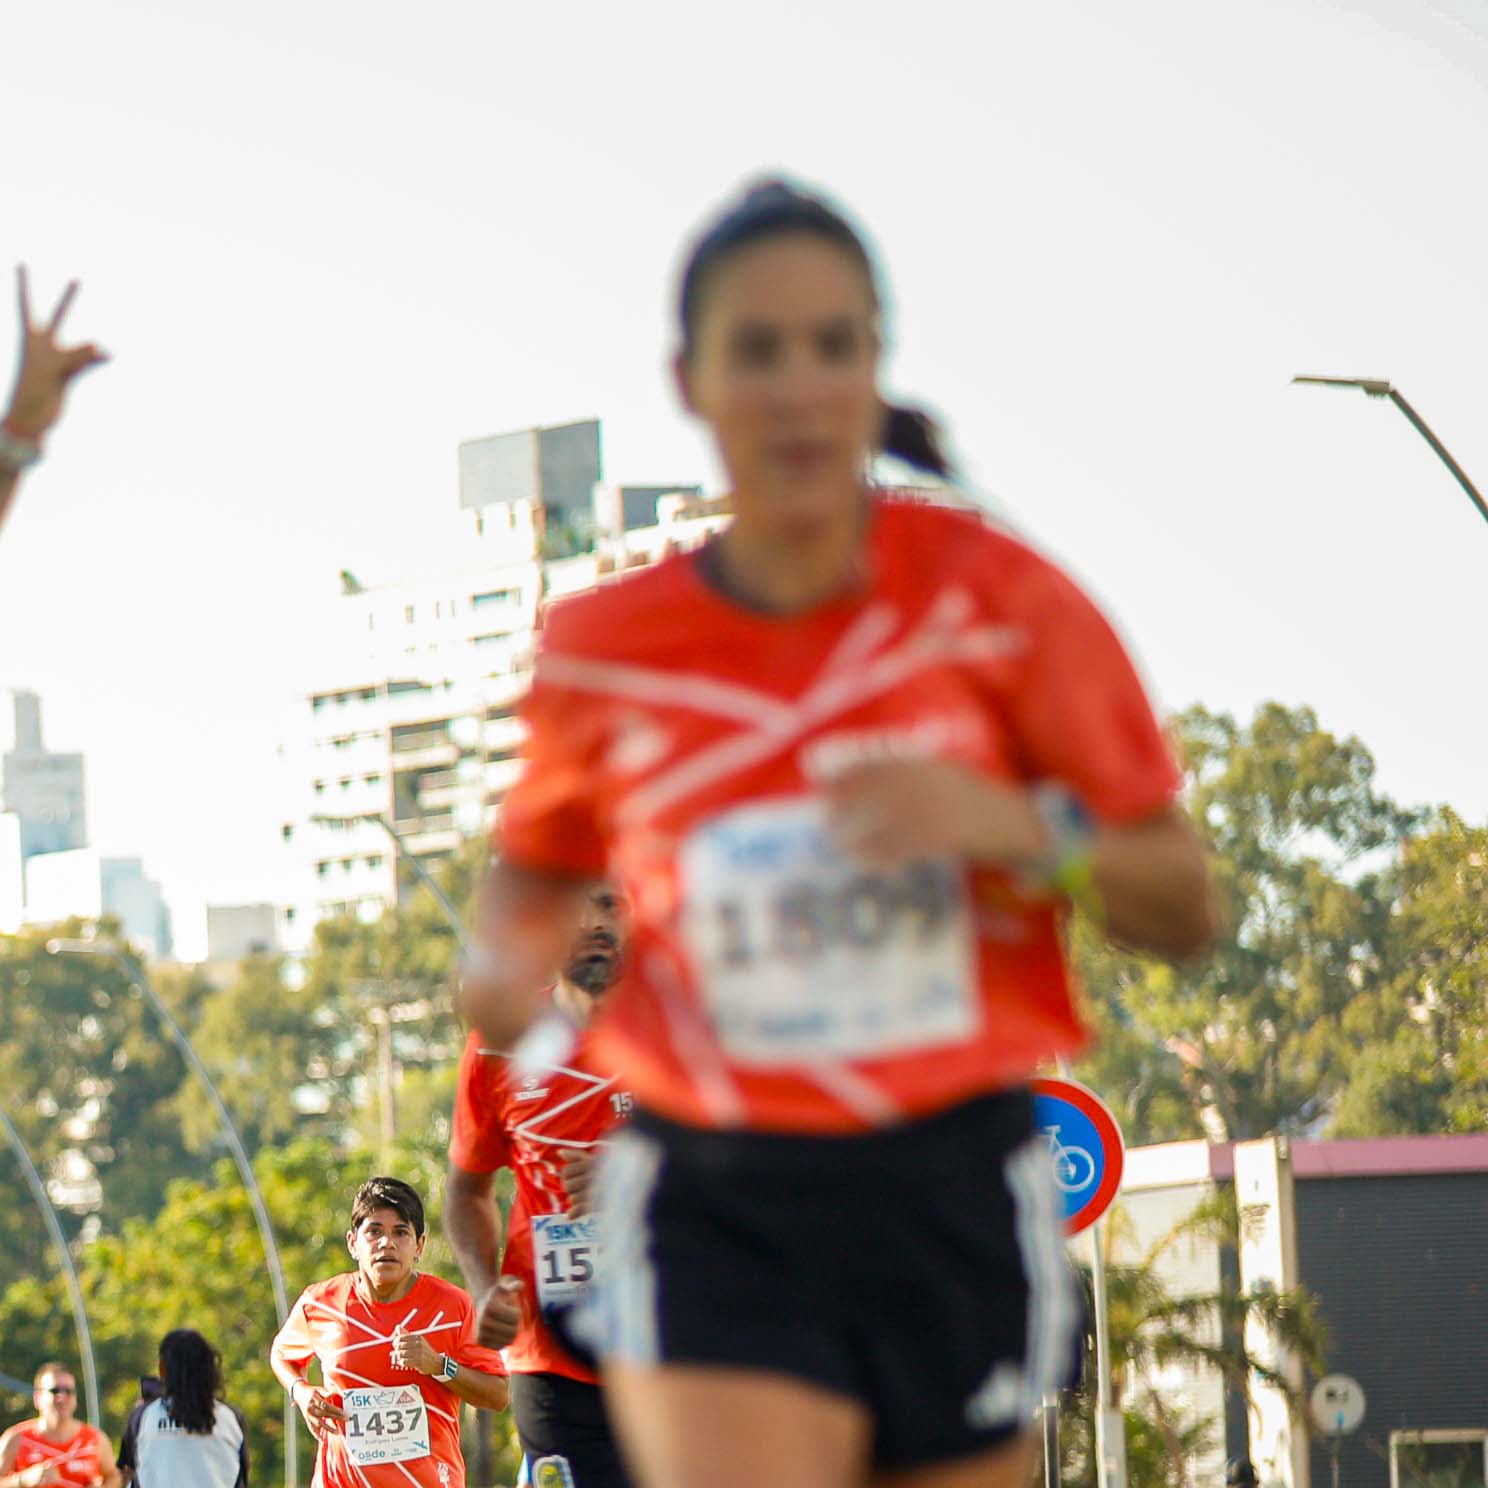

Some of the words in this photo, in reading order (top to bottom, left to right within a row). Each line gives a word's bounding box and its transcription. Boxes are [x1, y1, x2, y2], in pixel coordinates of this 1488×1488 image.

[609, 1092, 634, 1113] 15
[542, 1246, 598, 1284] 15
[352, 1395, 372, 1406] 15K
[349, 1407, 422, 1437] 1437
